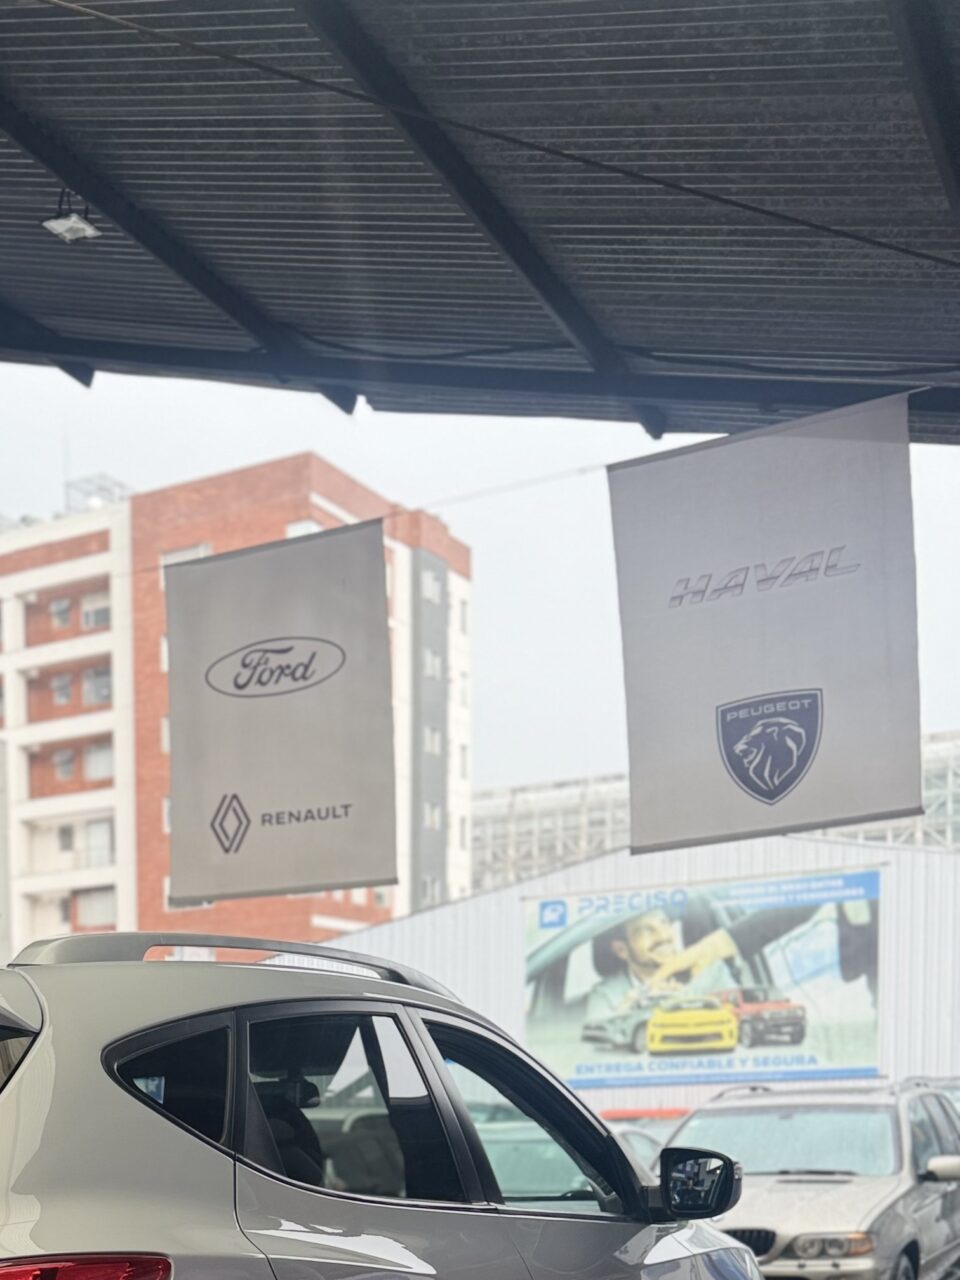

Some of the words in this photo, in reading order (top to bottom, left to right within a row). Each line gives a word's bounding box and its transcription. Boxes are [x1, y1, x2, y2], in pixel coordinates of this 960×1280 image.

[668, 544, 861, 608] HAVAL
[233, 646, 317, 691] Ford
[727, 699, 813, 723] PEUGEOT
[260, 804, 352, 827] RENAULT
[753, 1054, 818, 1069] SEGURA
